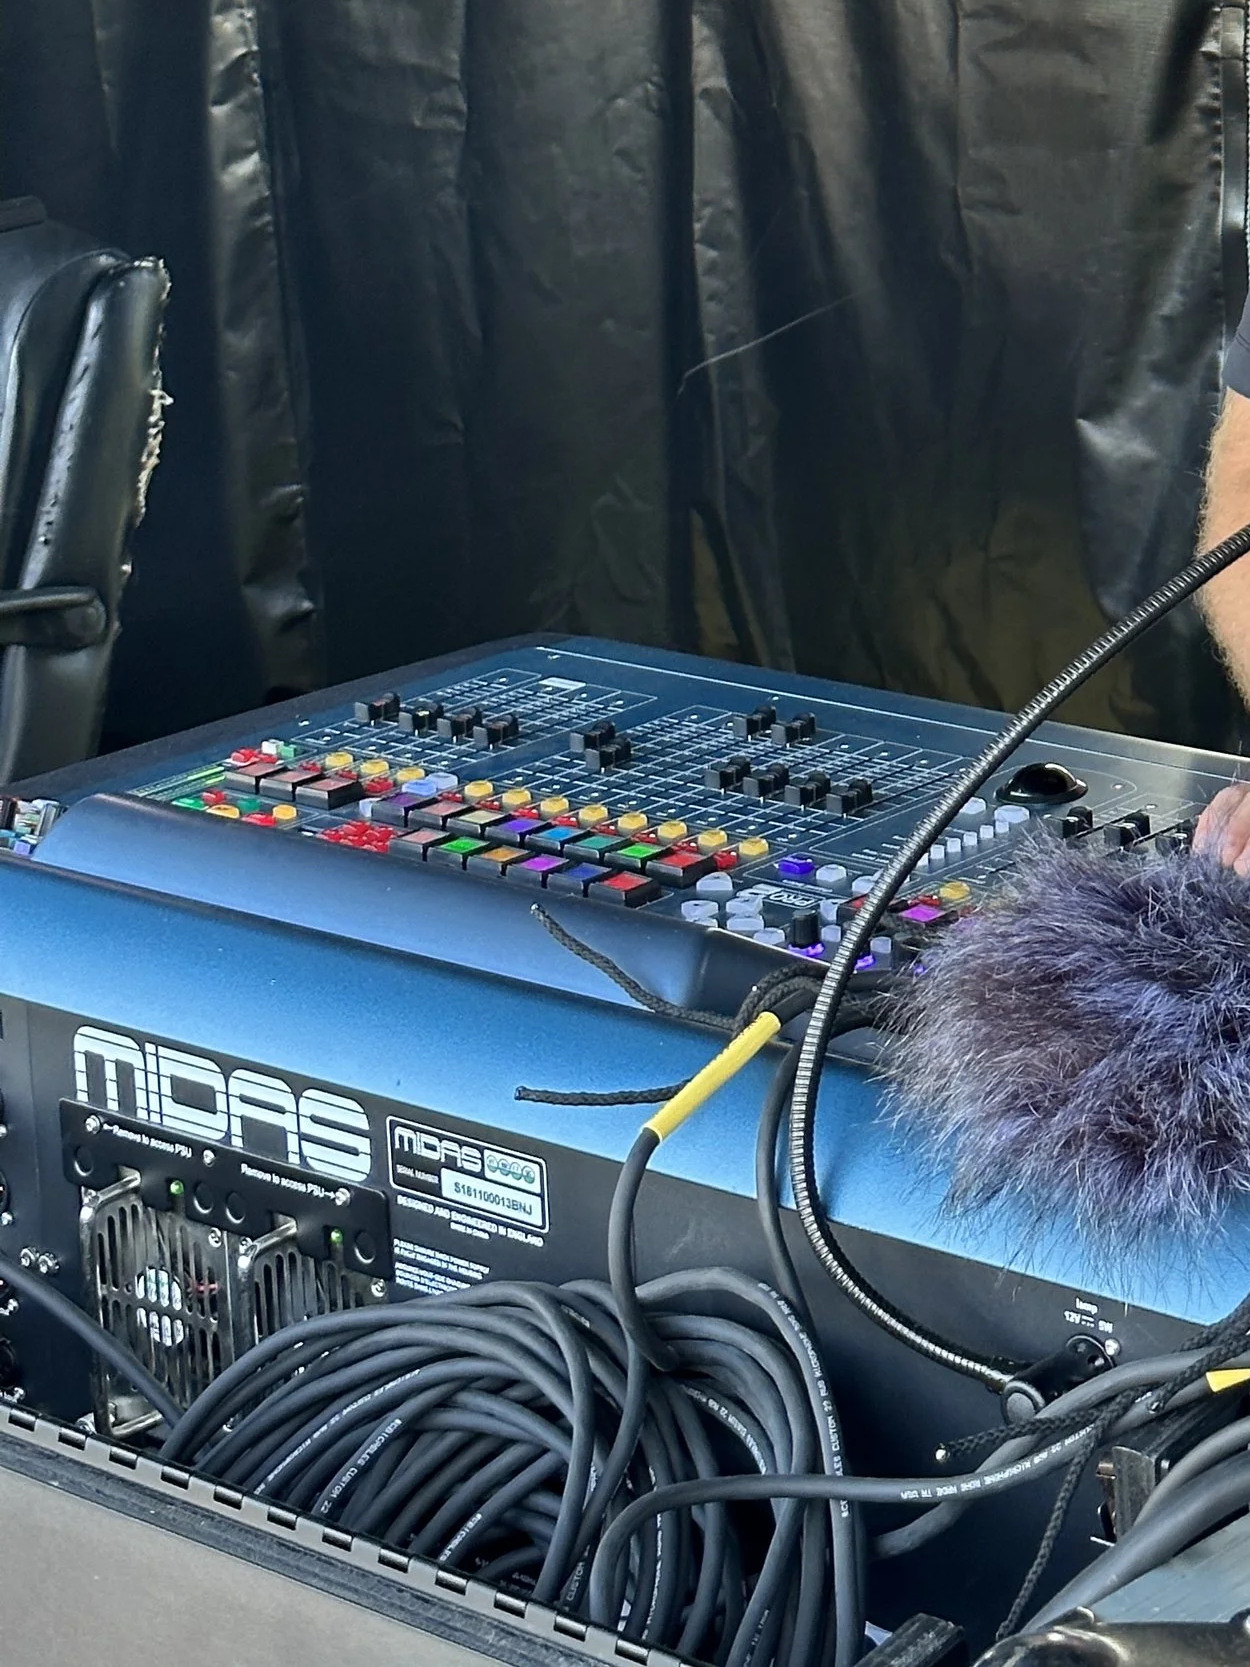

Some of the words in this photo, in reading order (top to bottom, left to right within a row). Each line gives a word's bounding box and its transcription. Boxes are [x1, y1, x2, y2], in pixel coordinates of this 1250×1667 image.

[174, 1140, 193, 1160] PSU
[394, 1126, 482, 1173] MIDAS
[305, 1181, 325, 1199] PSU
